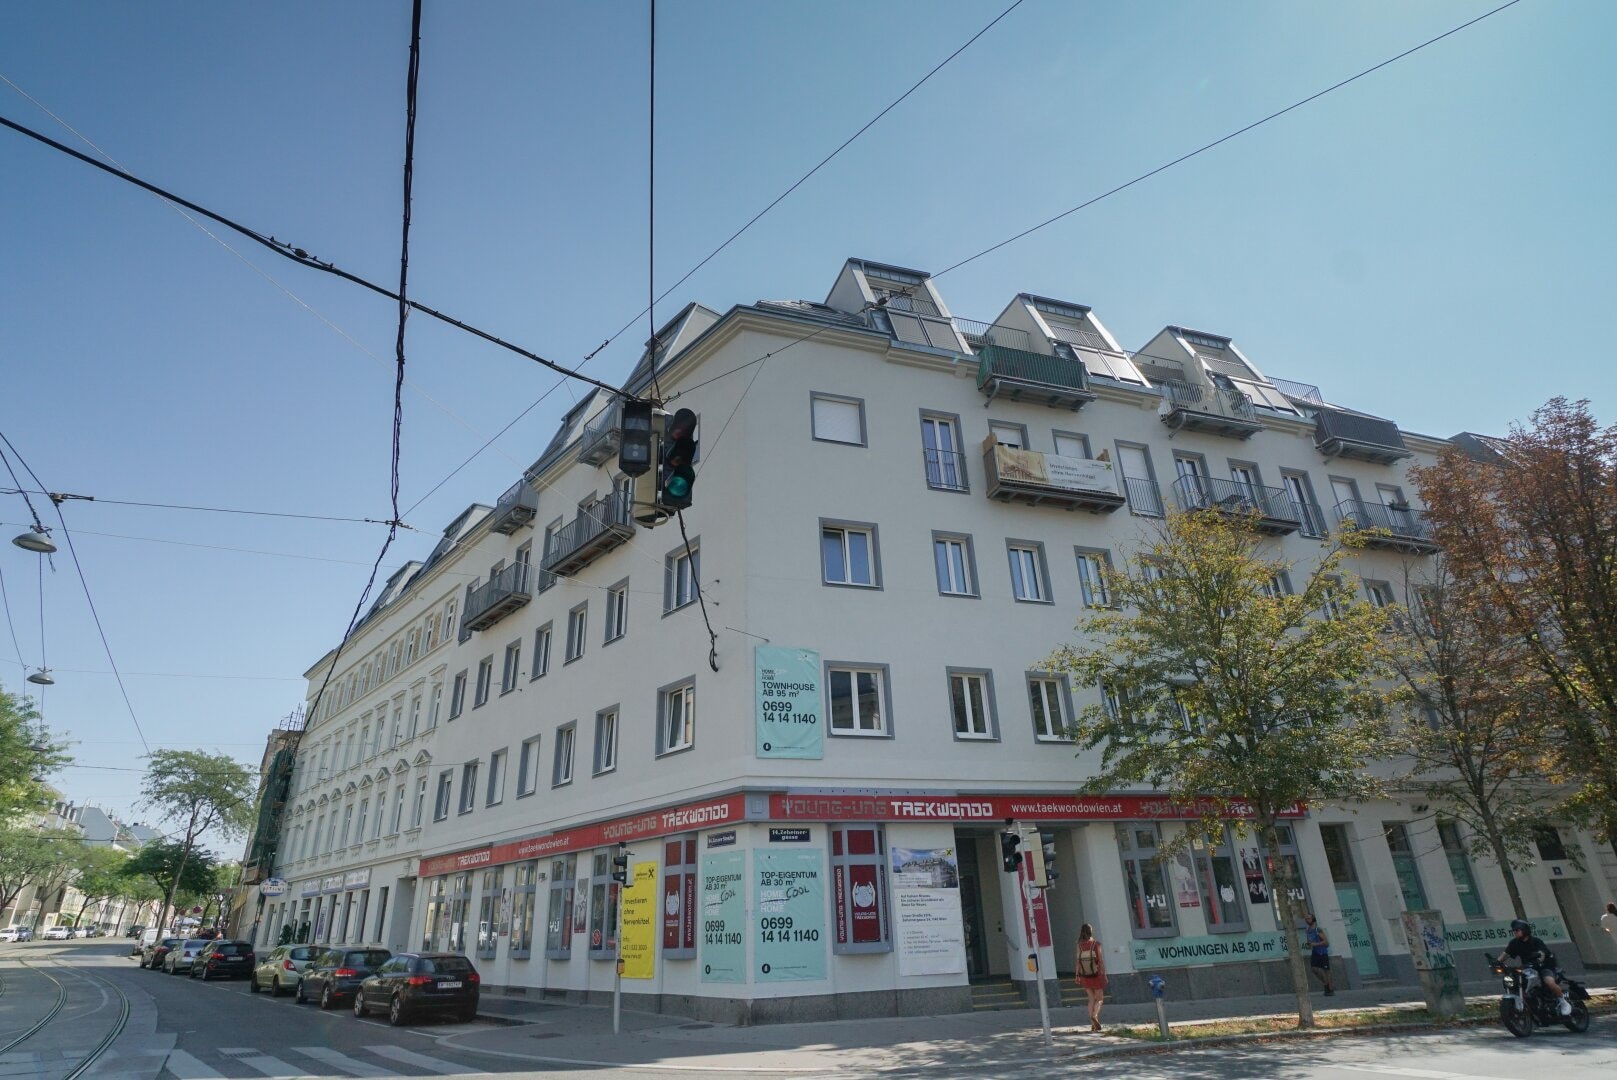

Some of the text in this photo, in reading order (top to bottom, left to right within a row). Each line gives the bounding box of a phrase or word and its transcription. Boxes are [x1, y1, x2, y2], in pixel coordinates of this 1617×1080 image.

[762, 682, 815, 691] TOWNHOUSE
[763, 701, 792, 712] 0699
[763, 712, 816, 724] 14 14 1140
[891, 802, 992, 817] TAEKWONDO
[1011, 802, 1123, 813] www.taekwondowien.at
[662, 804, 729, 828] TAEKWONDO
[458, 851, 490, 866] TAEKWONDO
[706, 874, 741, 883] TOP-EIGENTUM
[786, 878, 795, 886] m²
[786, 886, 810, 899] COOL
[761, 905, 784, 913] HOME
[705, 920, 725, 932] 0699
[761, 917, 793, 930] 0699
[705, 932, 741, 944] 14 14 1140
[761, 929, 819, 943] 14 14 1140
[1485, 929, 1496, 940] AB
[1497, 929, 1507, 938] 95
[1158, 939, 1275, 959] WOHNUNGEN AB 30 m²
